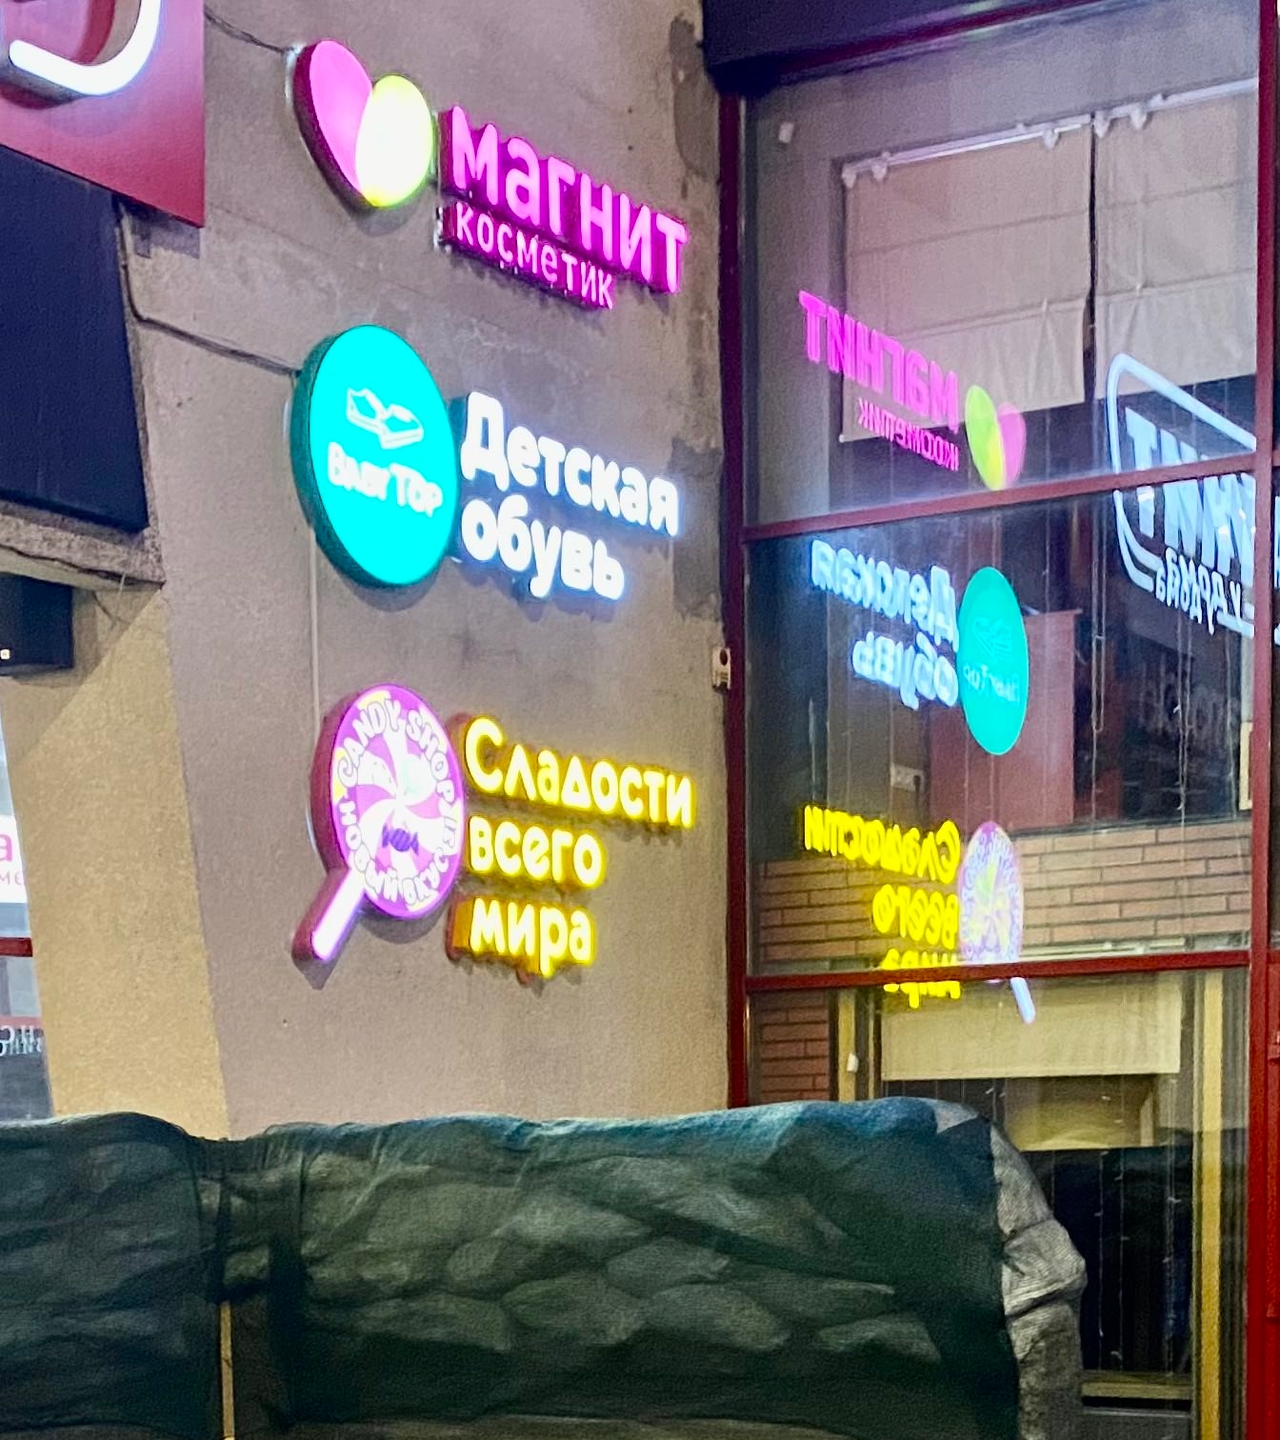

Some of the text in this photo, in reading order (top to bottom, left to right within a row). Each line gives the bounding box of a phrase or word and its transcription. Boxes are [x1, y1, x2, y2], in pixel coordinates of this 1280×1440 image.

[460, 391, 679, 536] Детская
[460, 494, 625, 601] обувь
[337, 698, 456, 805] CANDY SHOP
[465, 714, 695, 830] Сладости
[467, 815, 606, 888] всего
[470, 895, 598, 980] мира
